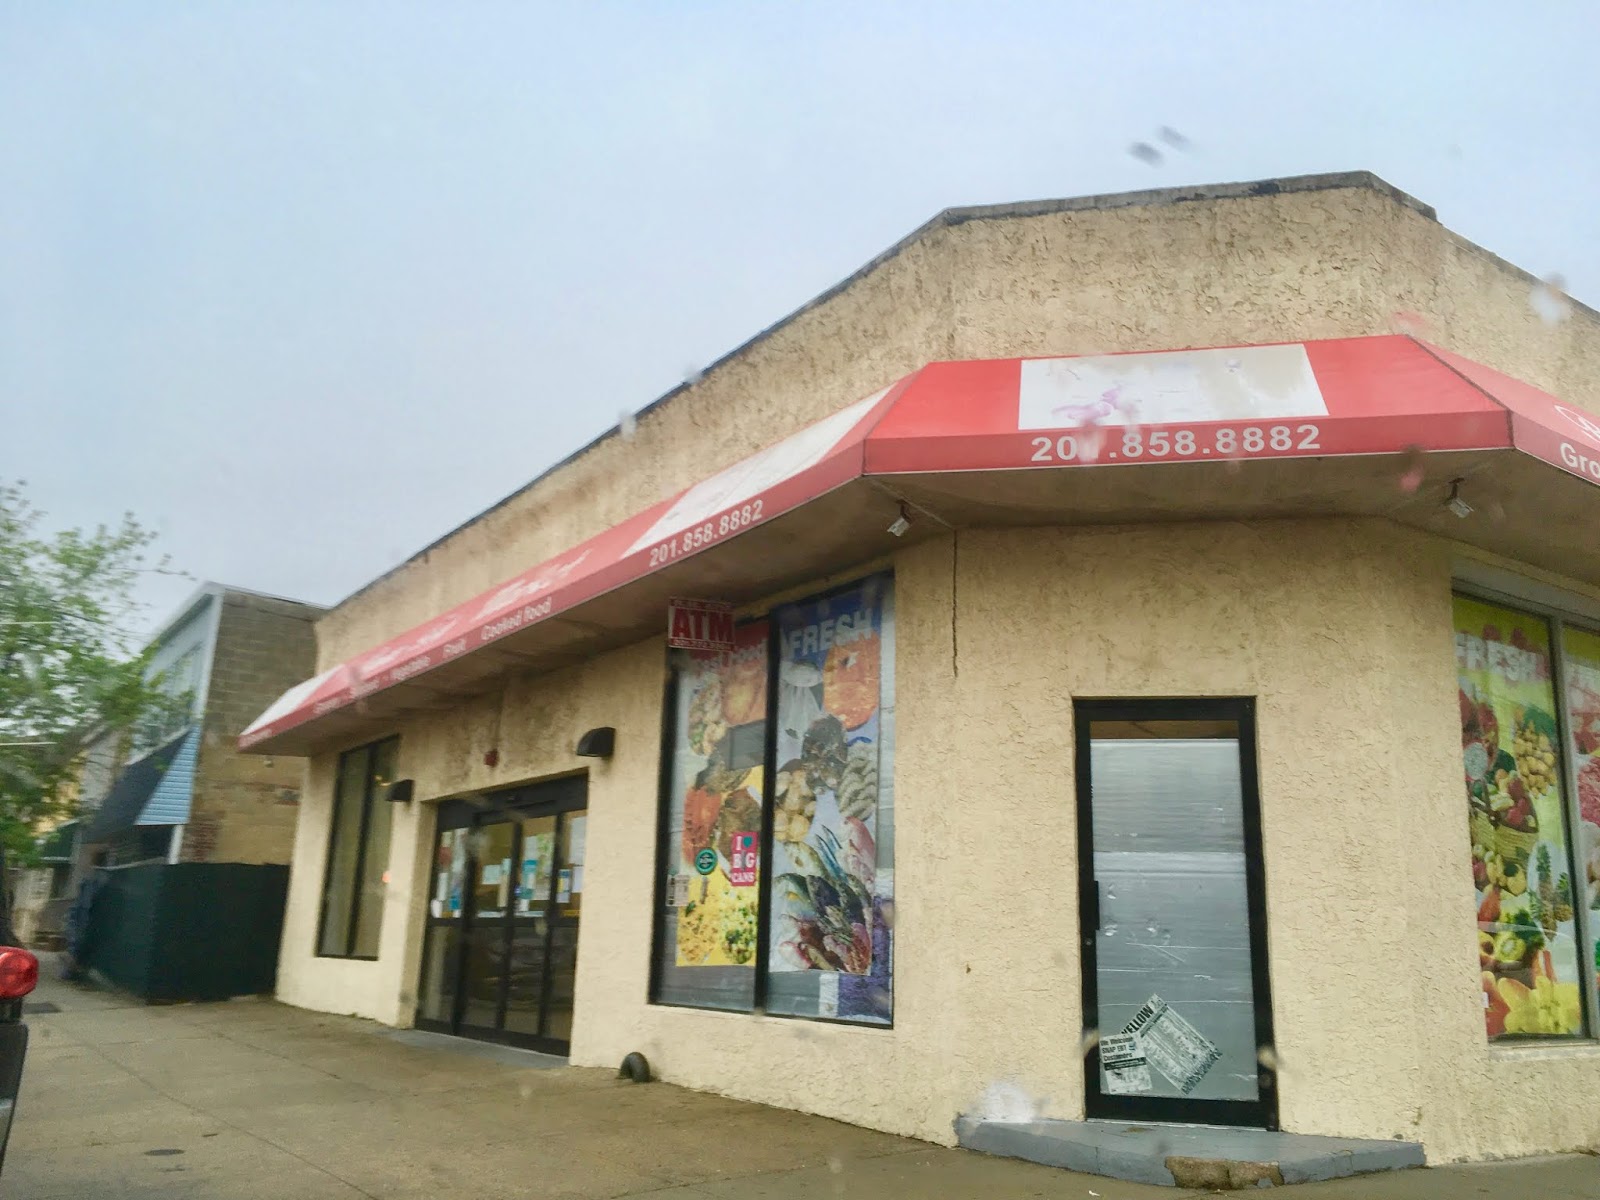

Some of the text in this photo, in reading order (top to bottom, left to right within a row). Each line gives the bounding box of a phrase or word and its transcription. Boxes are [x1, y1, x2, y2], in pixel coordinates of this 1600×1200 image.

[649, 499, 764, 568] 201.858.8882
[671, 607, 734, 642] ATM
[788, 607, 874, 660] FRESH
[736, 835, 742, 851] I
